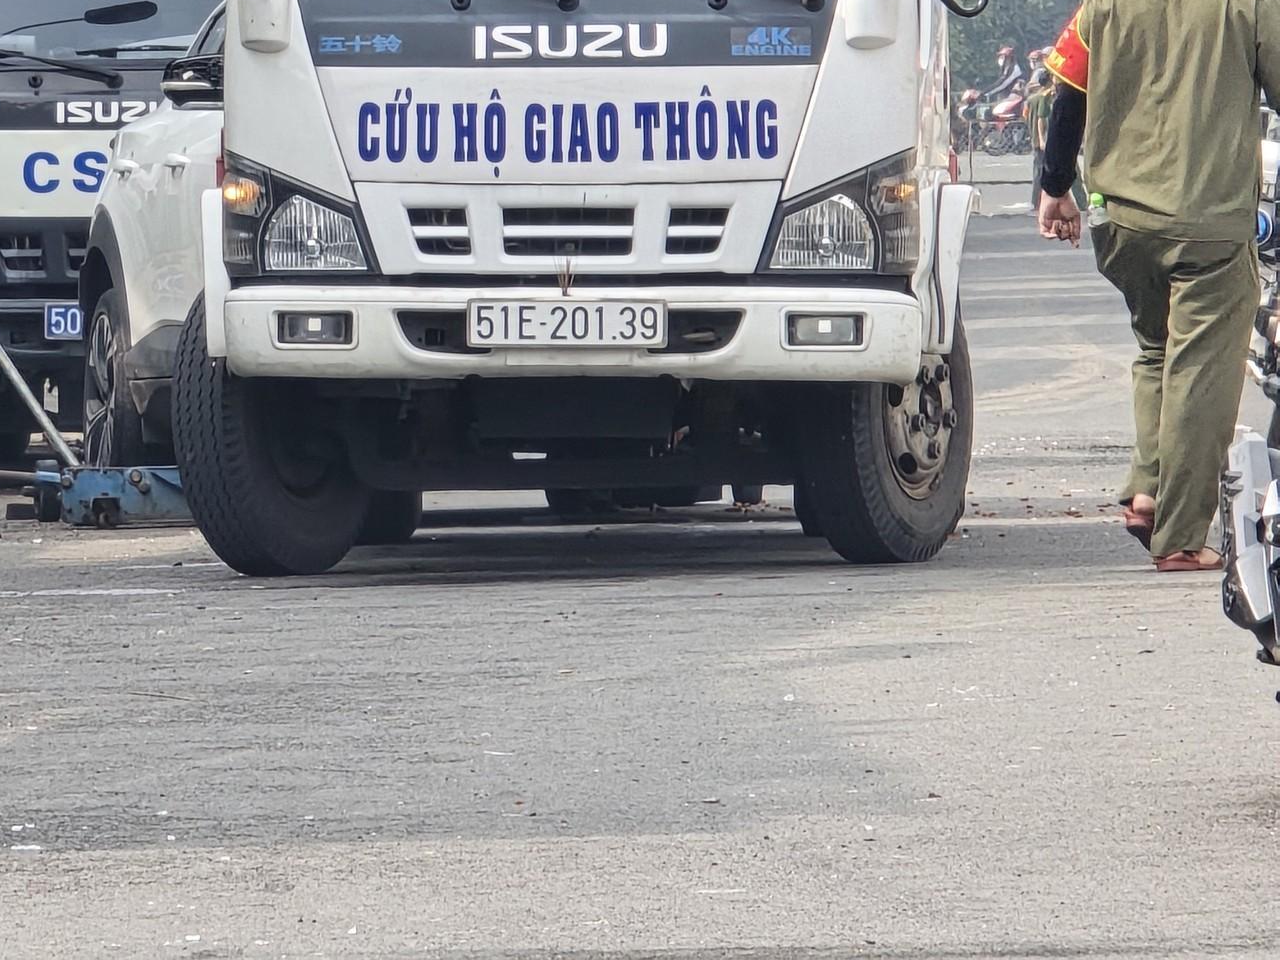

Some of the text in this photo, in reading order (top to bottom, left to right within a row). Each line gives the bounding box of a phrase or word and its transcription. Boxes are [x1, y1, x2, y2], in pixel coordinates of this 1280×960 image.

[474, 23, 669, 60] ISUZU
[731, 44, 812, 57] ENGINE
[746, 26, 792, 46] 4K
[56, 101, 158, 124] ISUZ
[357, 85, 778, 178] CỨU HỘ GIAO THÔNG
[476, 306, 658, 341] 51E-201.39
